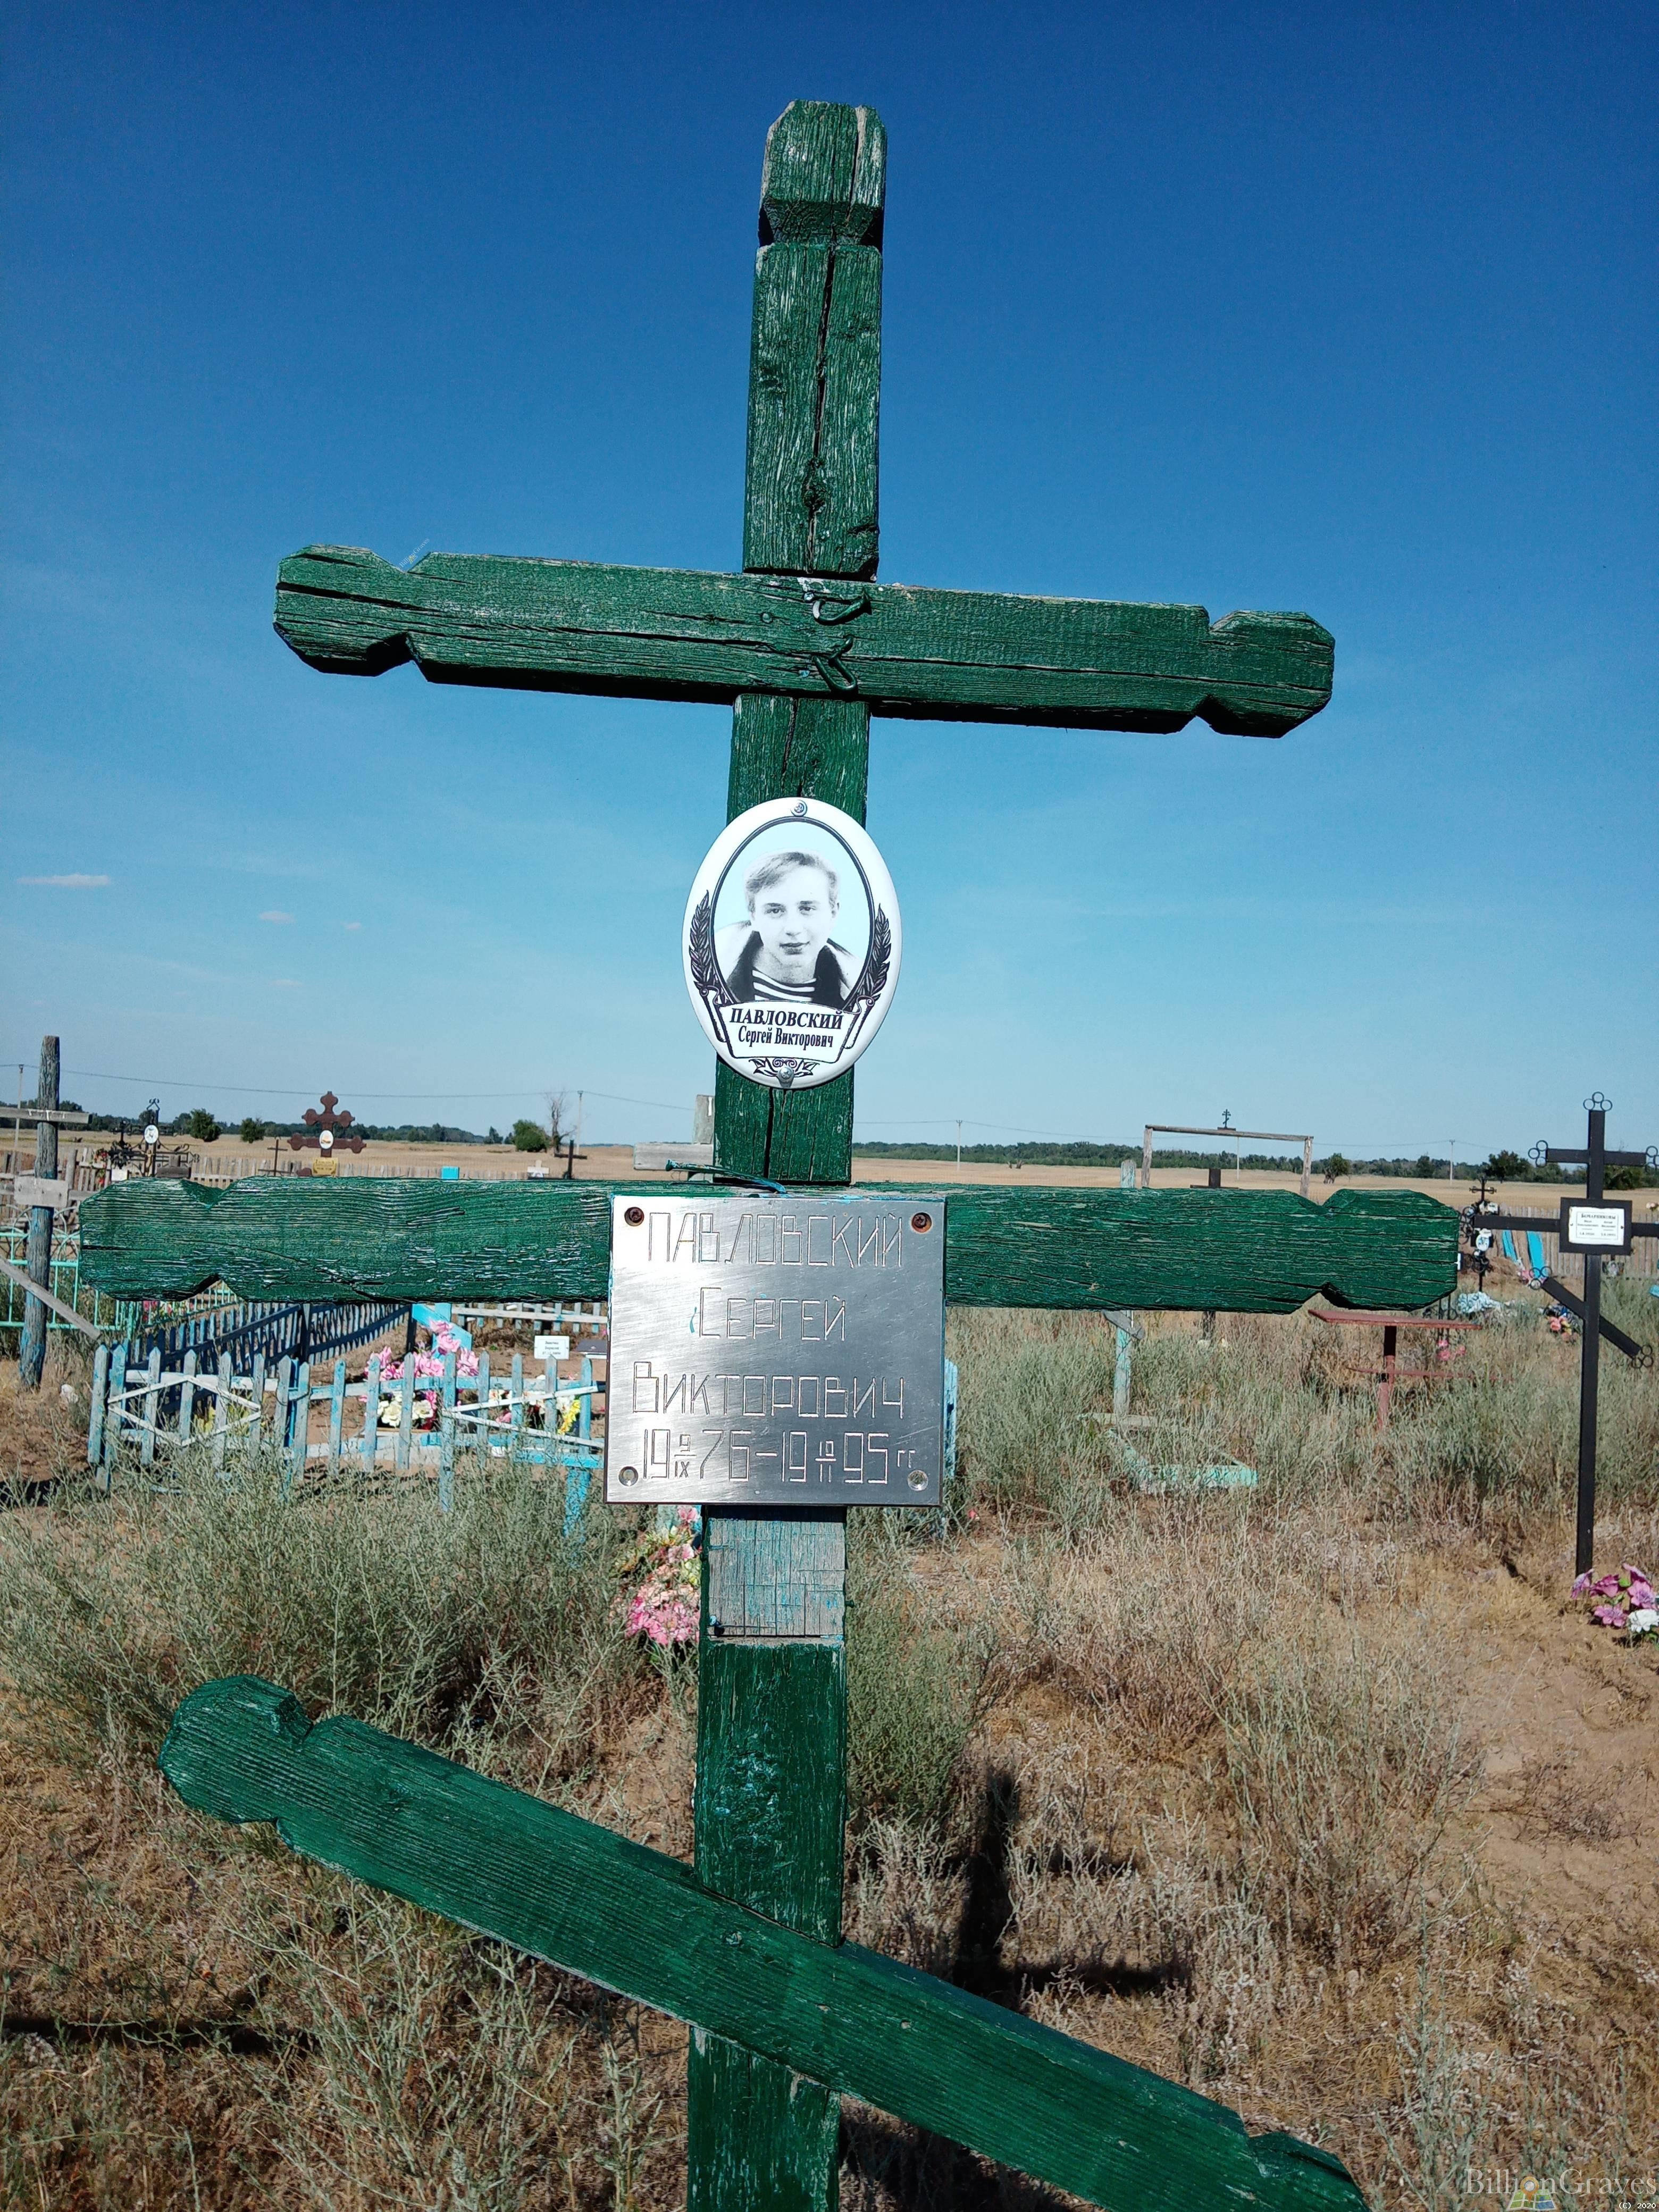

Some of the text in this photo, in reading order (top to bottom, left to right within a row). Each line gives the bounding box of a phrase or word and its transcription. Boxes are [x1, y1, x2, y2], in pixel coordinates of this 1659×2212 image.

[730, 1008, 843, 1029] ПАВЛОВСКИЙ
[738, 1025, 833, 1051] Сергей Викторович
[648, 1212, 902, 1268] ПАВЛОВСКИЙ
